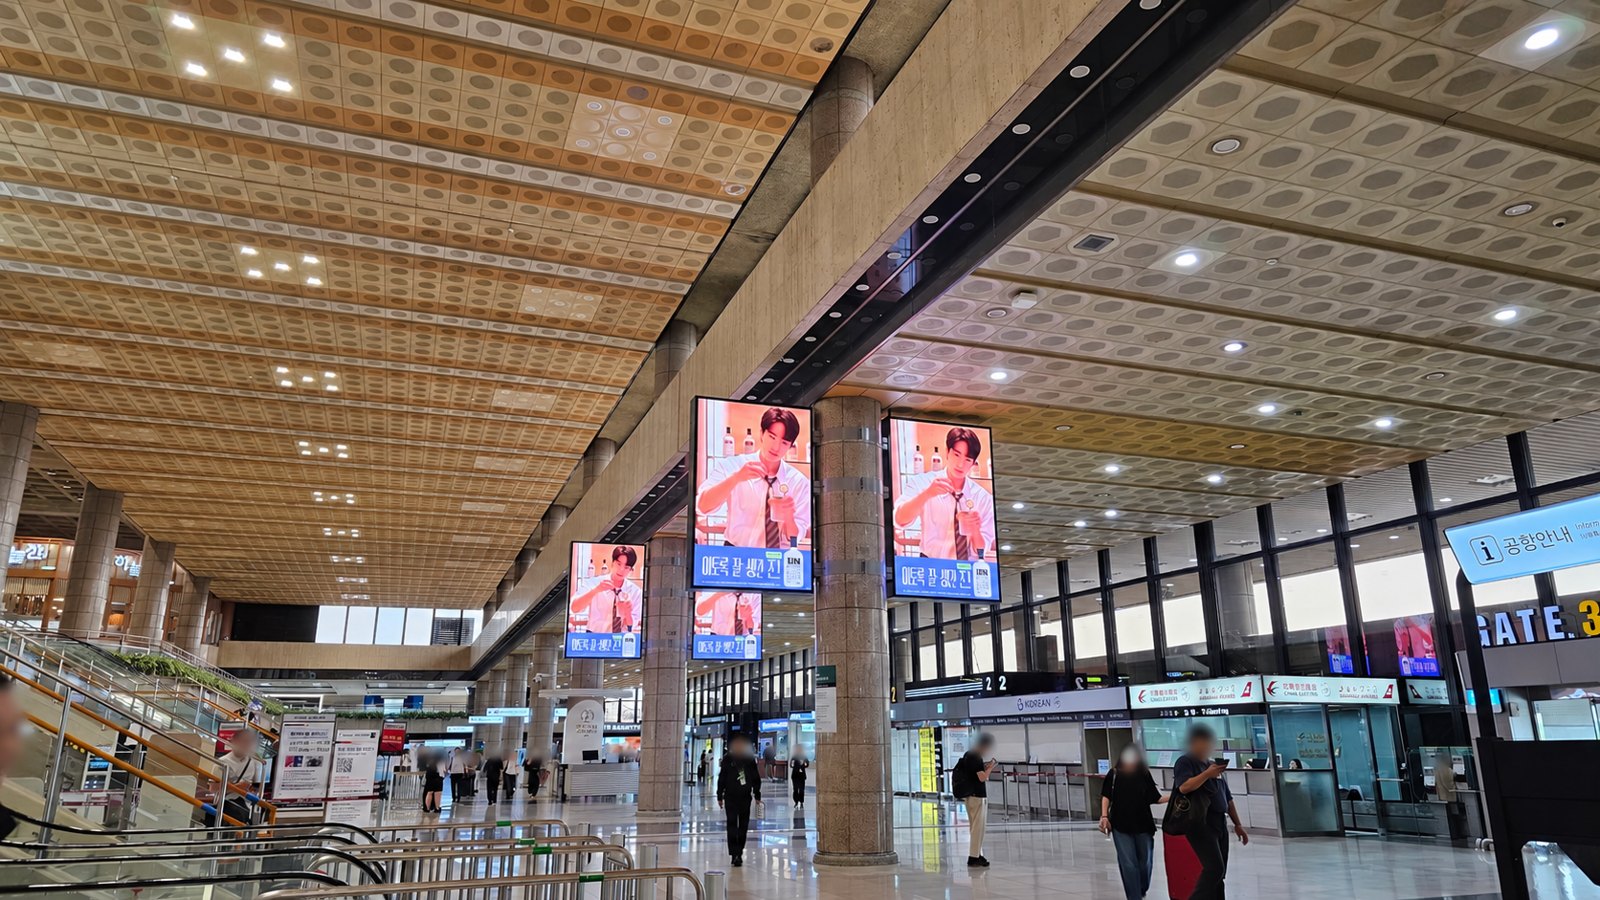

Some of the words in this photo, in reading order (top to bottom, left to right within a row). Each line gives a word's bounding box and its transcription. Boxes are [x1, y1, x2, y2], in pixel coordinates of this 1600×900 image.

[1503, 526, 1573, 556] 공항안내
[702, 555, 729, 577] 이토록
[767, 559, 781, 580] 진
[901, 566, 925, 587] 이토록
[959, 570, 972, 589] 진
[1579, 599, 1600, 636] 3
[986, 676, 992, 691] 2
[998, 675, 1007, 691] 2
[1024, 699, 1051, 708] KOREAN
